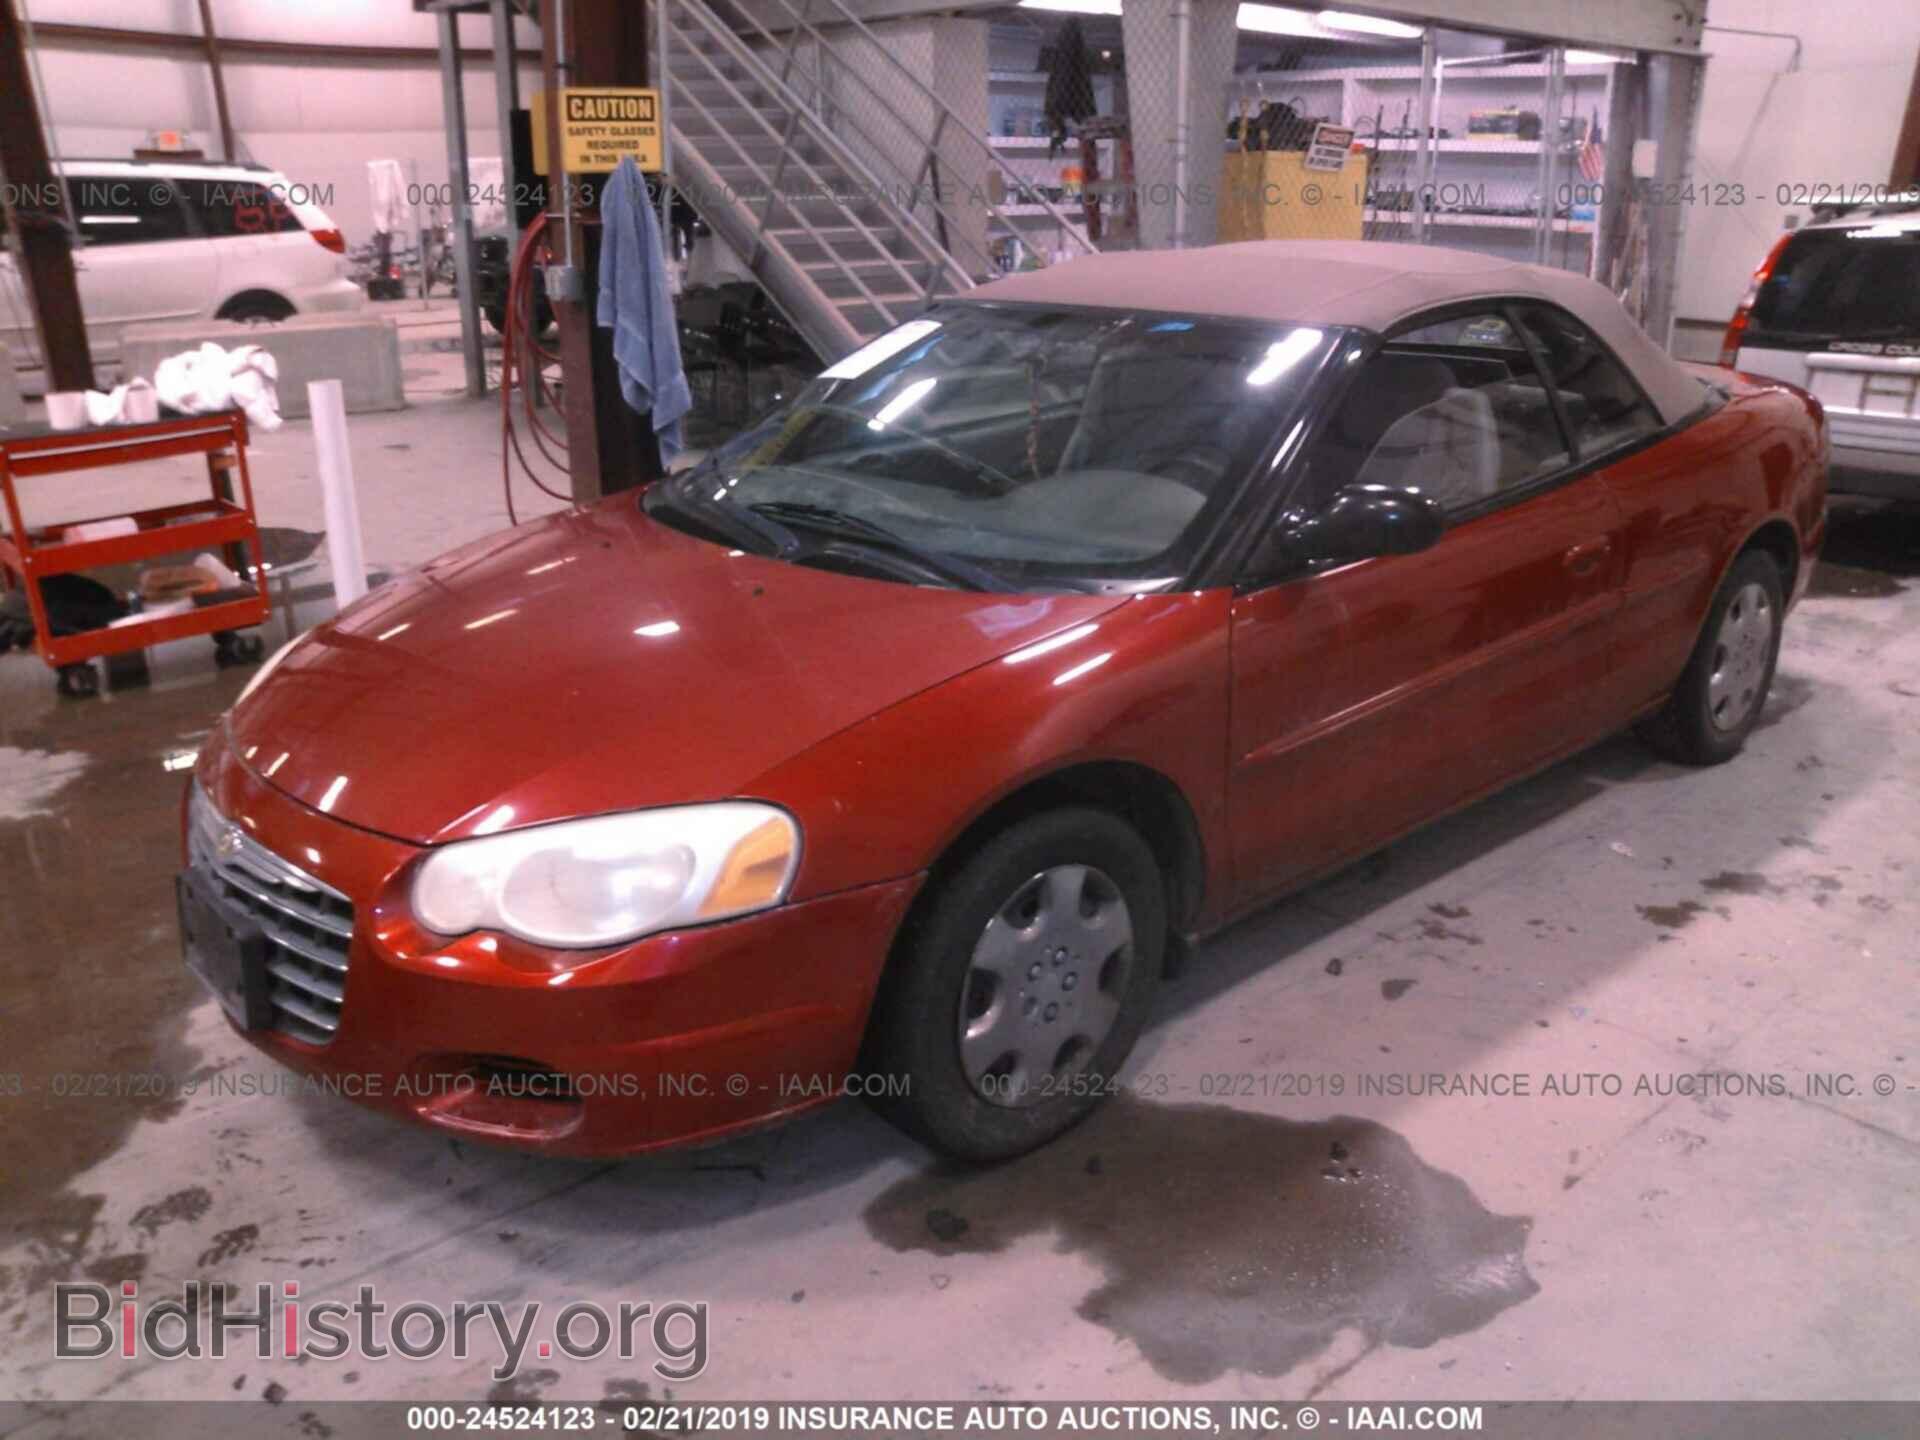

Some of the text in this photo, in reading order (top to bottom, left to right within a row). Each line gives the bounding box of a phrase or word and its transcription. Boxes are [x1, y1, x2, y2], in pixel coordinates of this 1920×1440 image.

[570, 97, 652, 119] CAUTION
[568, 126, 656, 136] SAFETY GLASSES
[587, 139, 640, 149] REQUIRED
